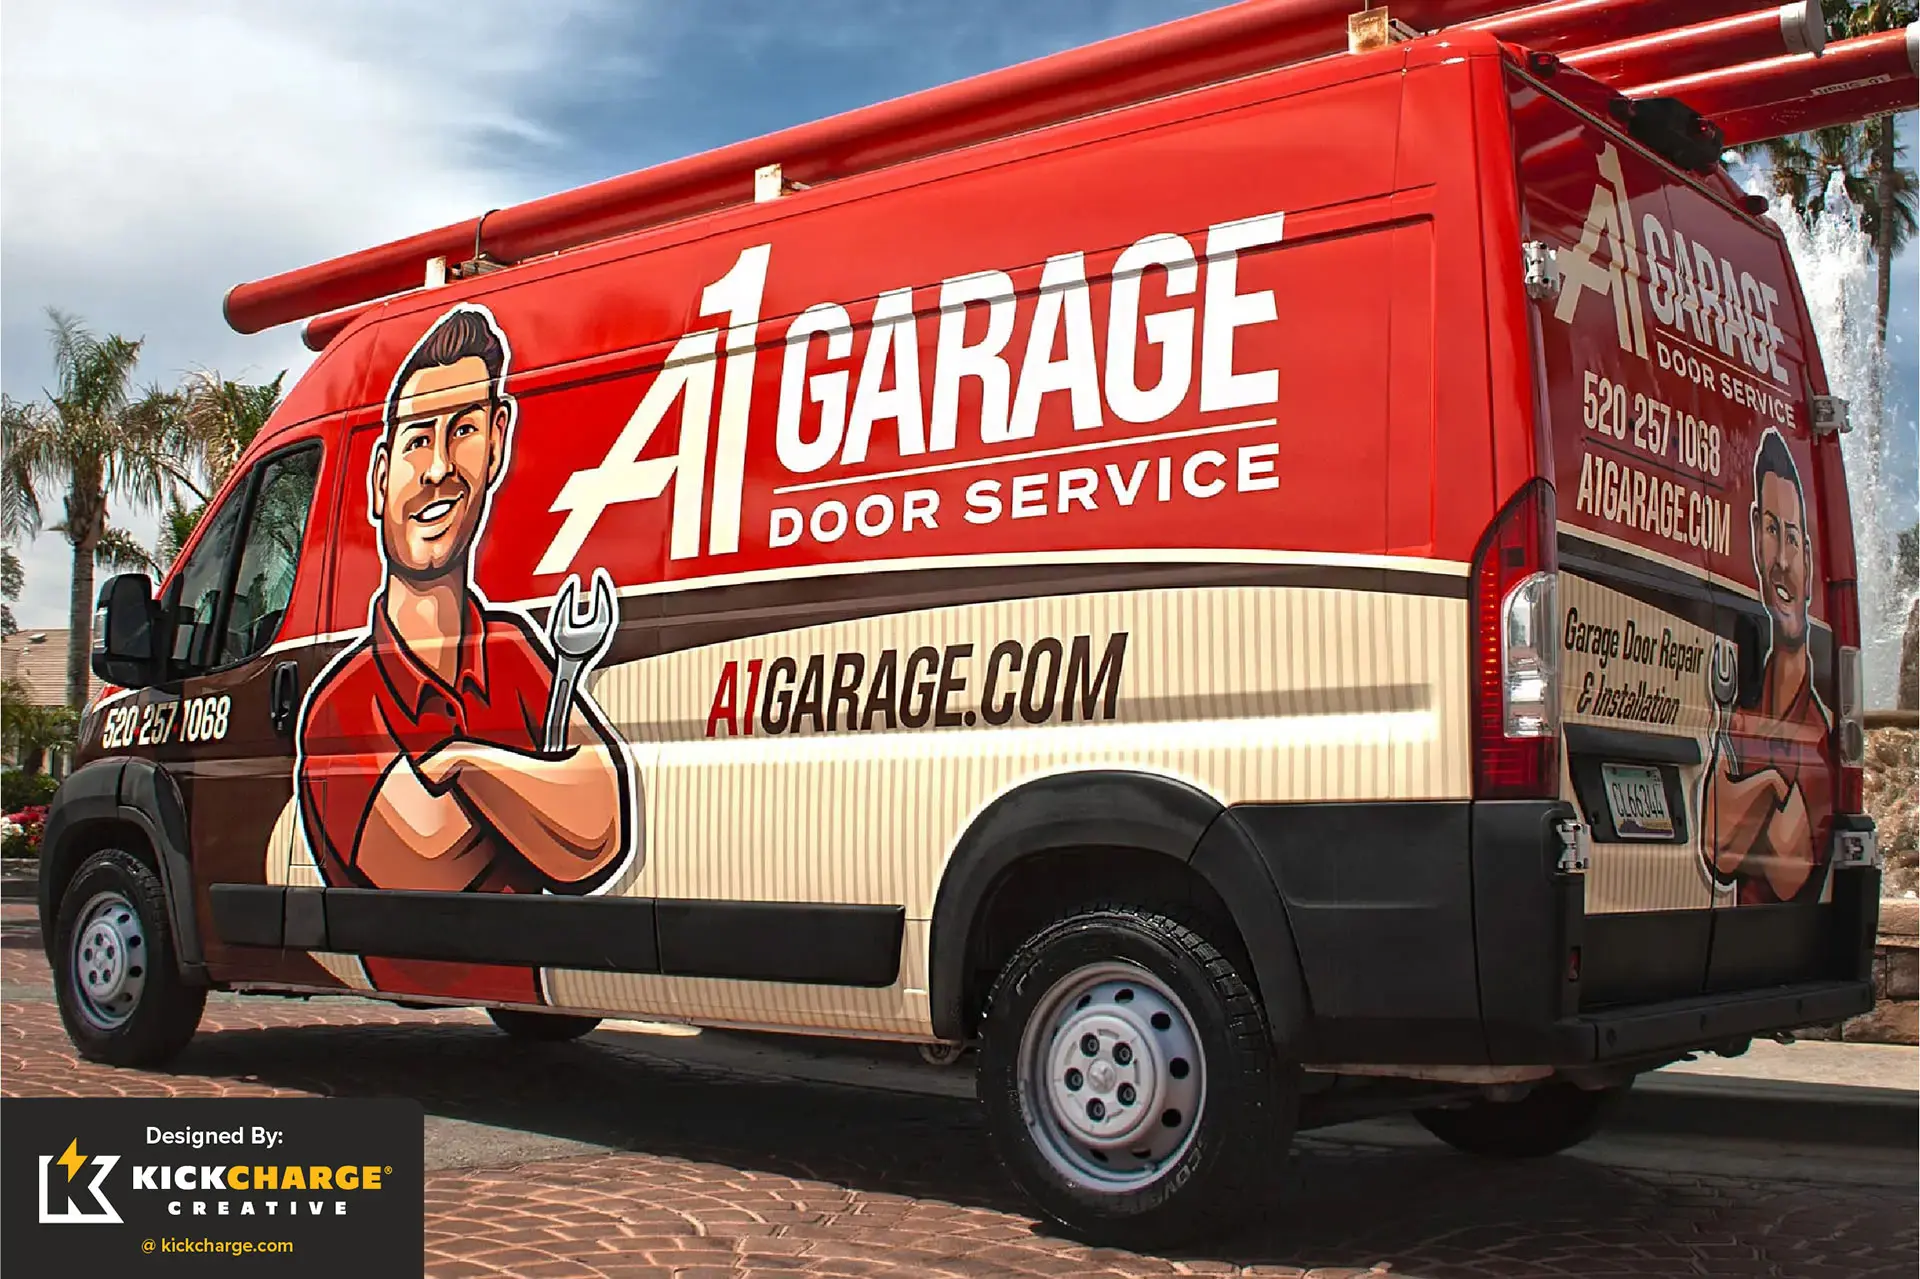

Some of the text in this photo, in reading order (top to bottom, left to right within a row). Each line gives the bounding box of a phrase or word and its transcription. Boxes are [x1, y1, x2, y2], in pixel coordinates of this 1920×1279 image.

[1554, 141, 1790, 385] A1 GARAGE
[533, 211, 1286, 575] A1 GARAGE
[1656, 341, 1796, 429] DOOR SERVICE
[769, 443, 1280, 549] DOOR SERVICE
[1576, 452, 1731, 556] A1GARAGE.COM
[705, 632, 1129, 738] A1GARAGE.COM
[1564, 606, 1704, 681] Garage Door Repair
[1576, 672, 1680, 725] & Installation
